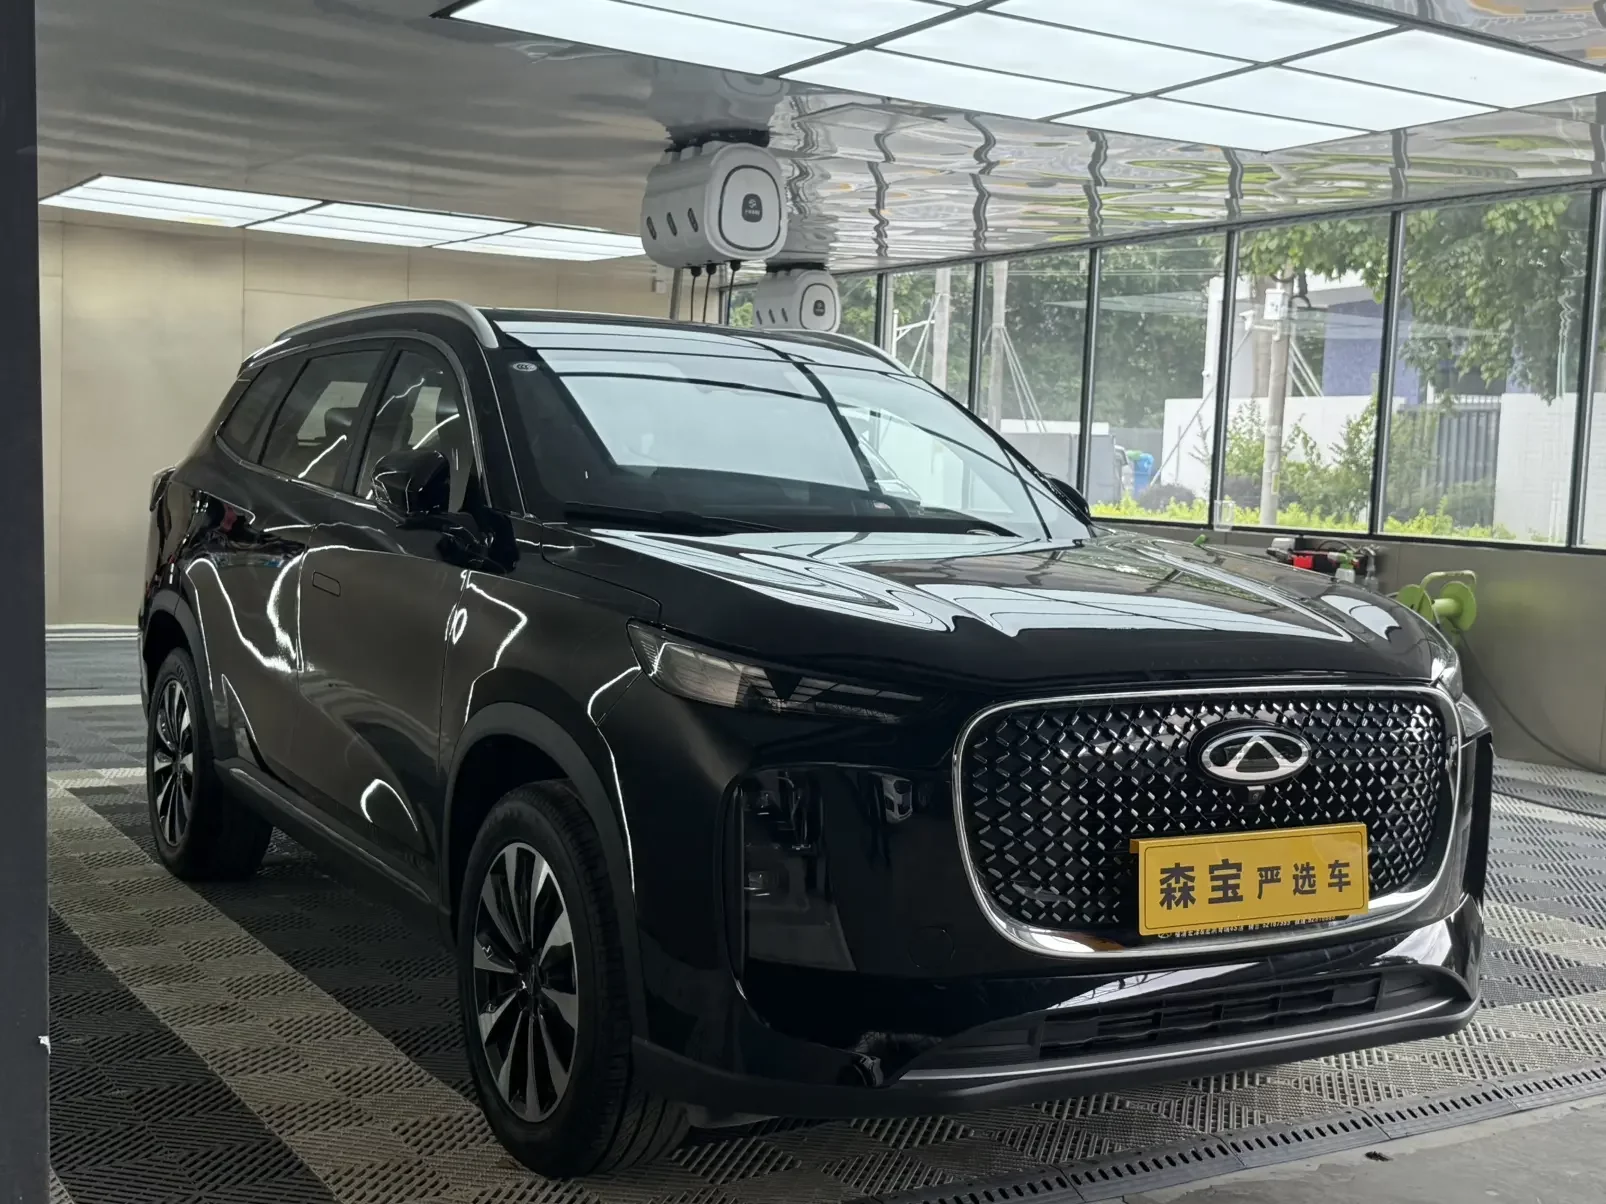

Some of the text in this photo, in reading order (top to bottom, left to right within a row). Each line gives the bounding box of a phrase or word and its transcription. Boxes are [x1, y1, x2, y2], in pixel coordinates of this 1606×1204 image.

[1159, 858, 1351, 910] 森宝严选车
